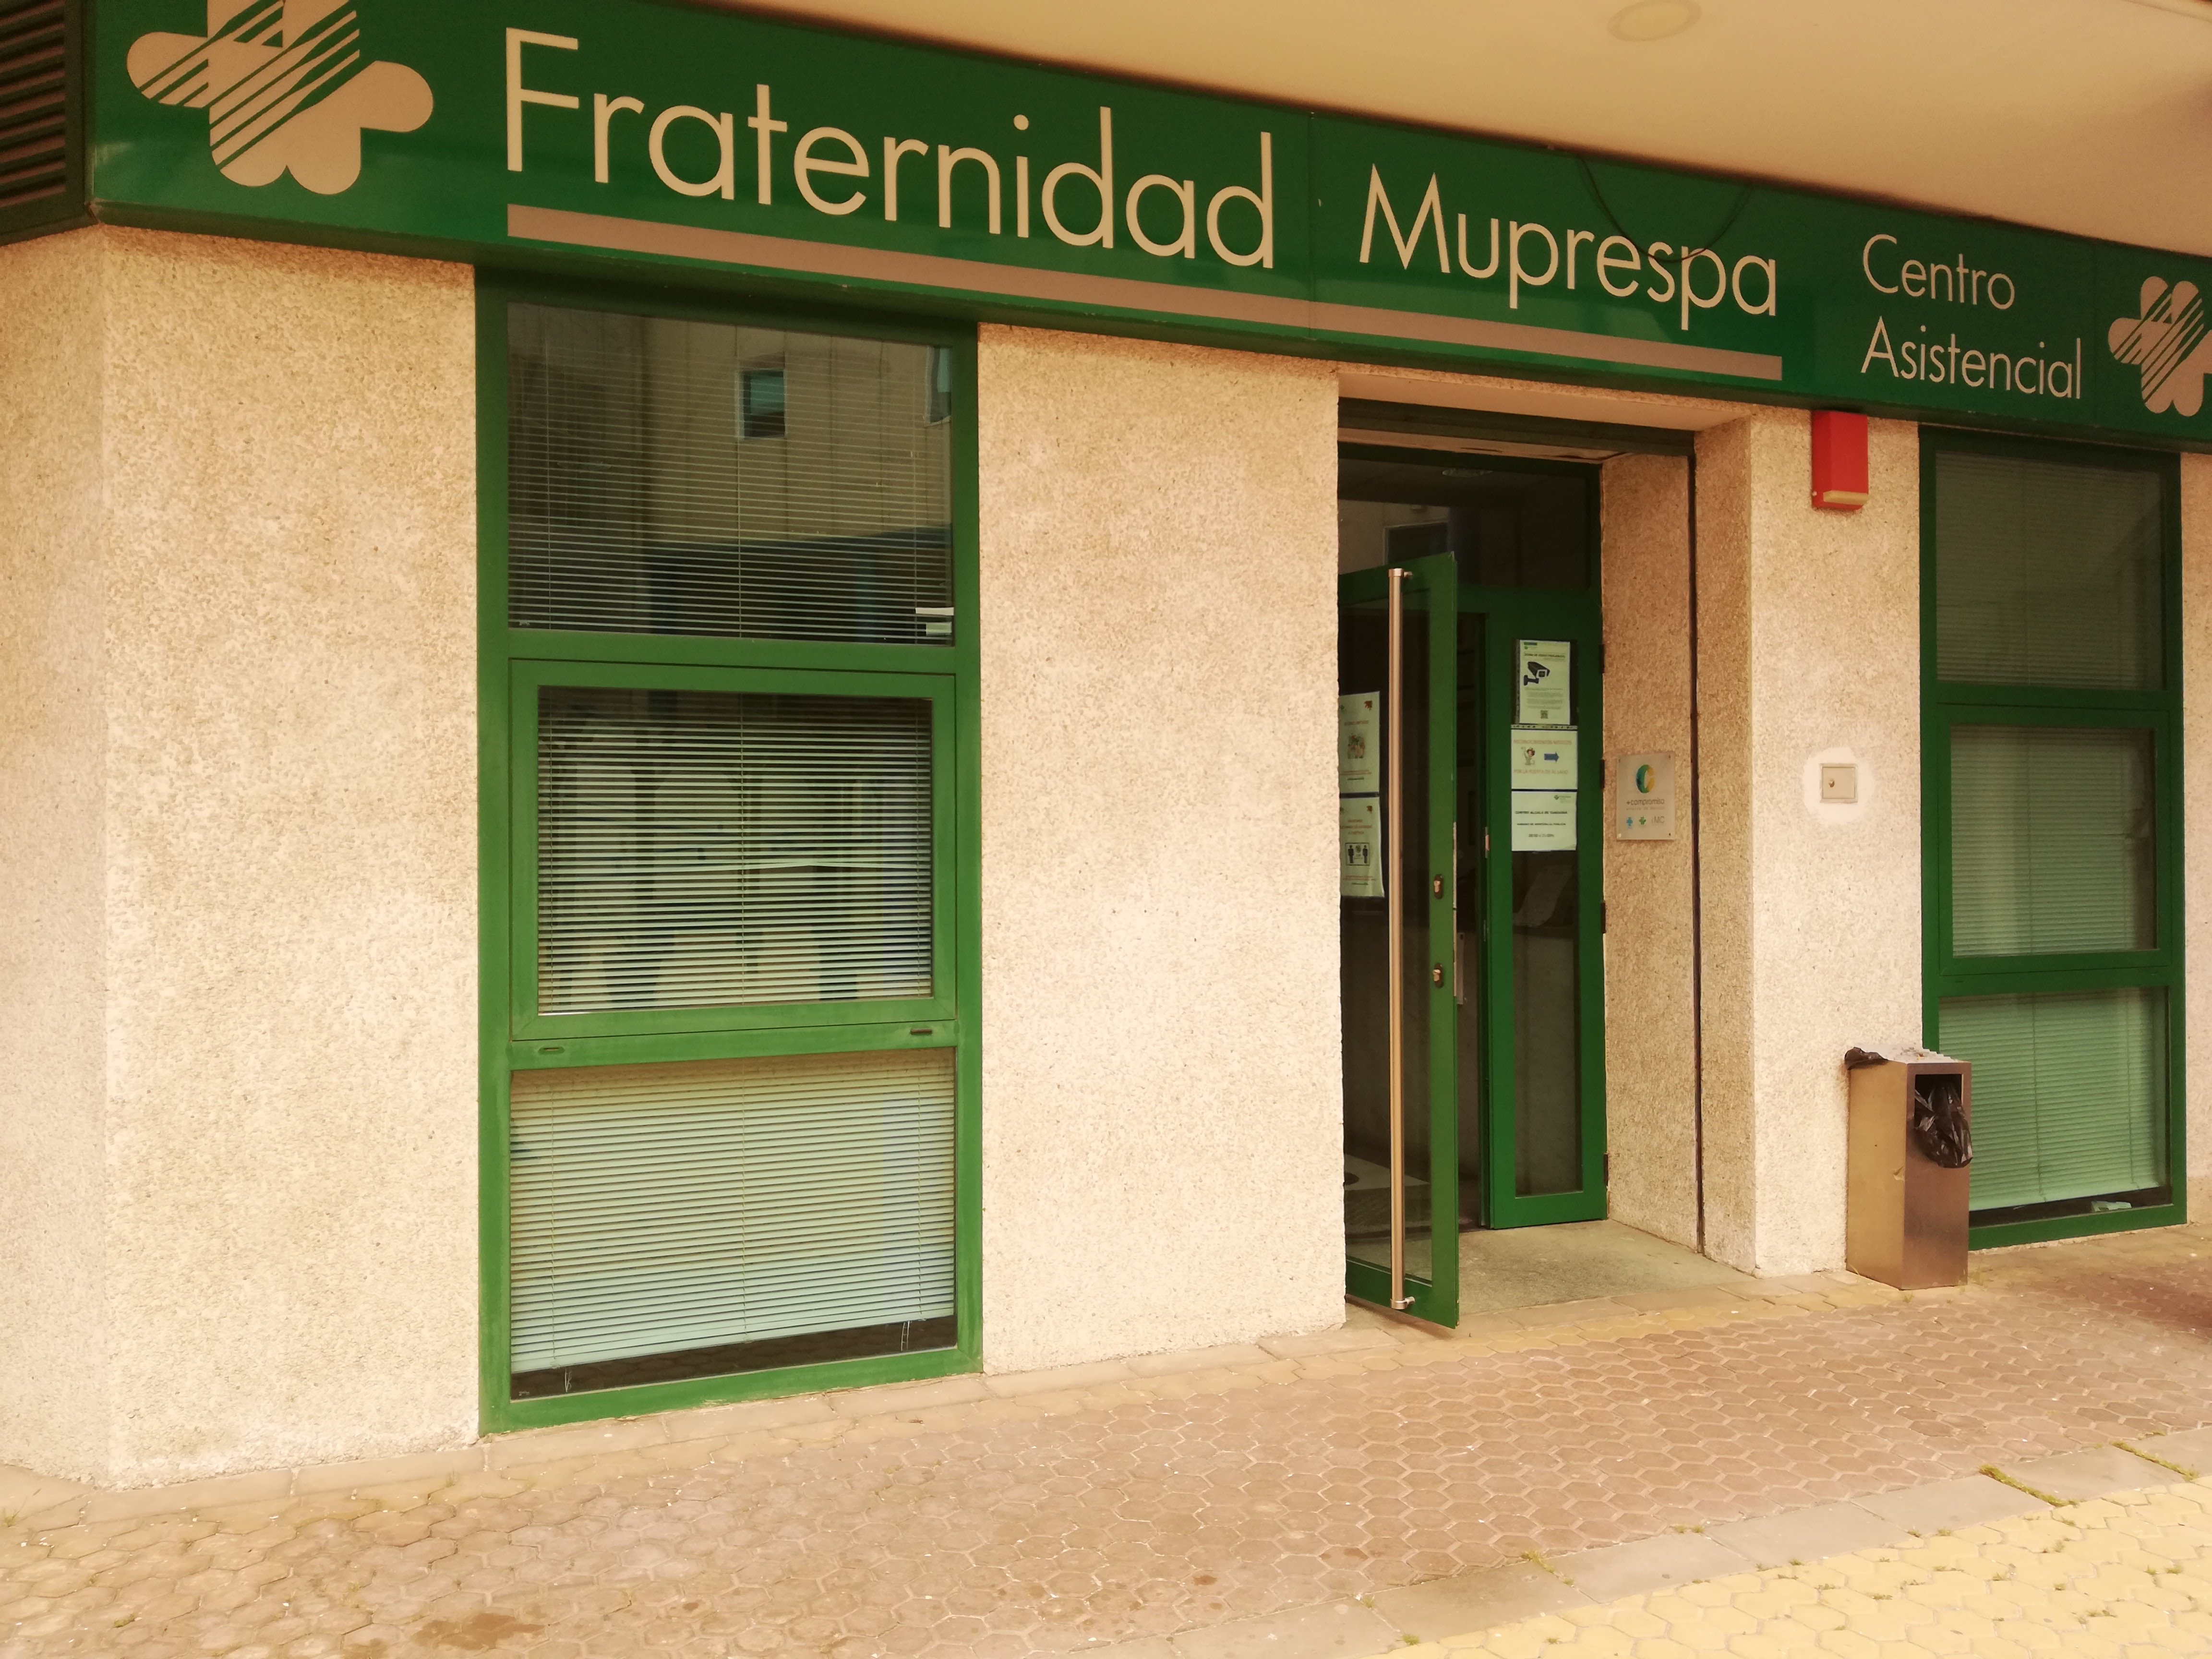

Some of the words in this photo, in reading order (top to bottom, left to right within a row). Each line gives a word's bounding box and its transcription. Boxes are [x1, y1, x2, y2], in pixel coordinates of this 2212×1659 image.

[505, 27, 1274, 269] Fraternidad
[1359, 164, 1776, 331] Muprespa
[1863, 234, 2015, 310] Centro
[1861, 317, 2081, 399] Asistencial
